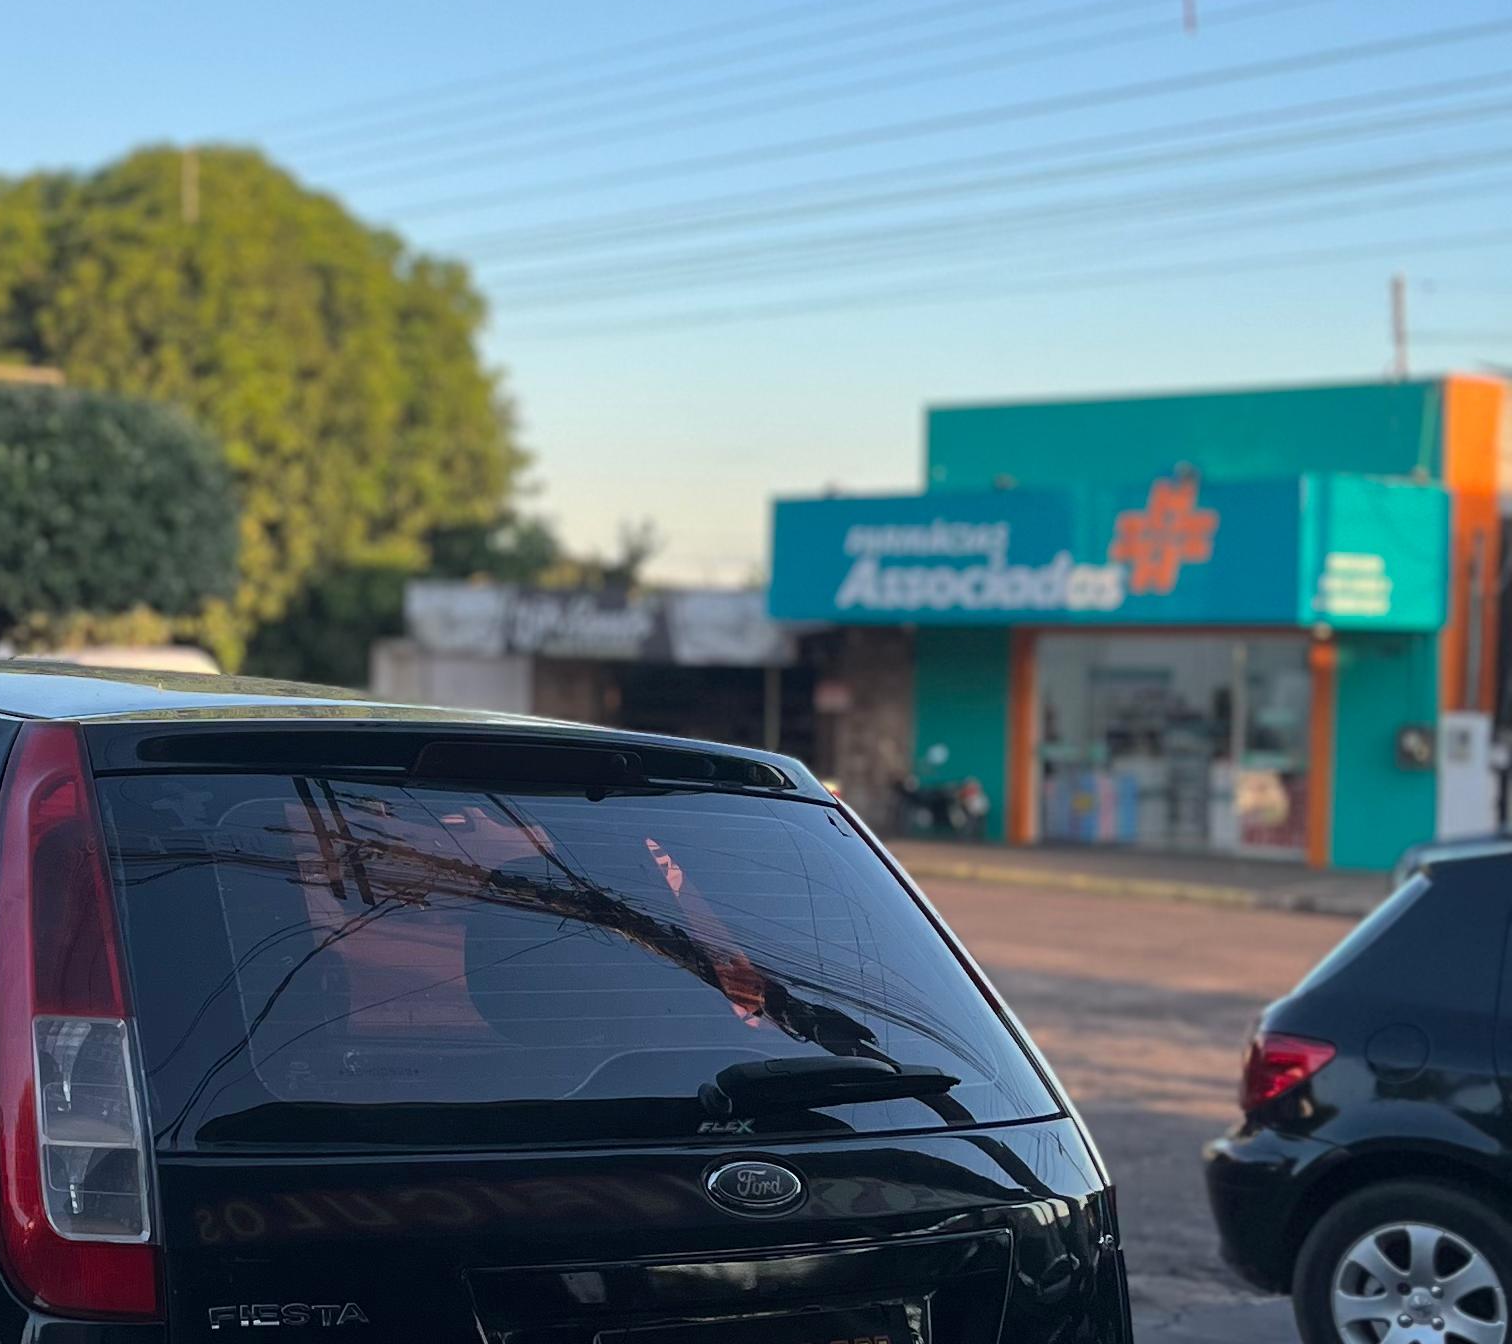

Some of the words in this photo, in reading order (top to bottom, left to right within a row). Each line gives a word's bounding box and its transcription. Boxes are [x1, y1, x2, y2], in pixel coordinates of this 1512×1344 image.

[836, 551, 1125, 610] Associadas
[697, 1118, 755, 1134] FLEX
[736, 1169, 783, 1197] Ford
[208, 1302, 370, 1330] FIESTA
